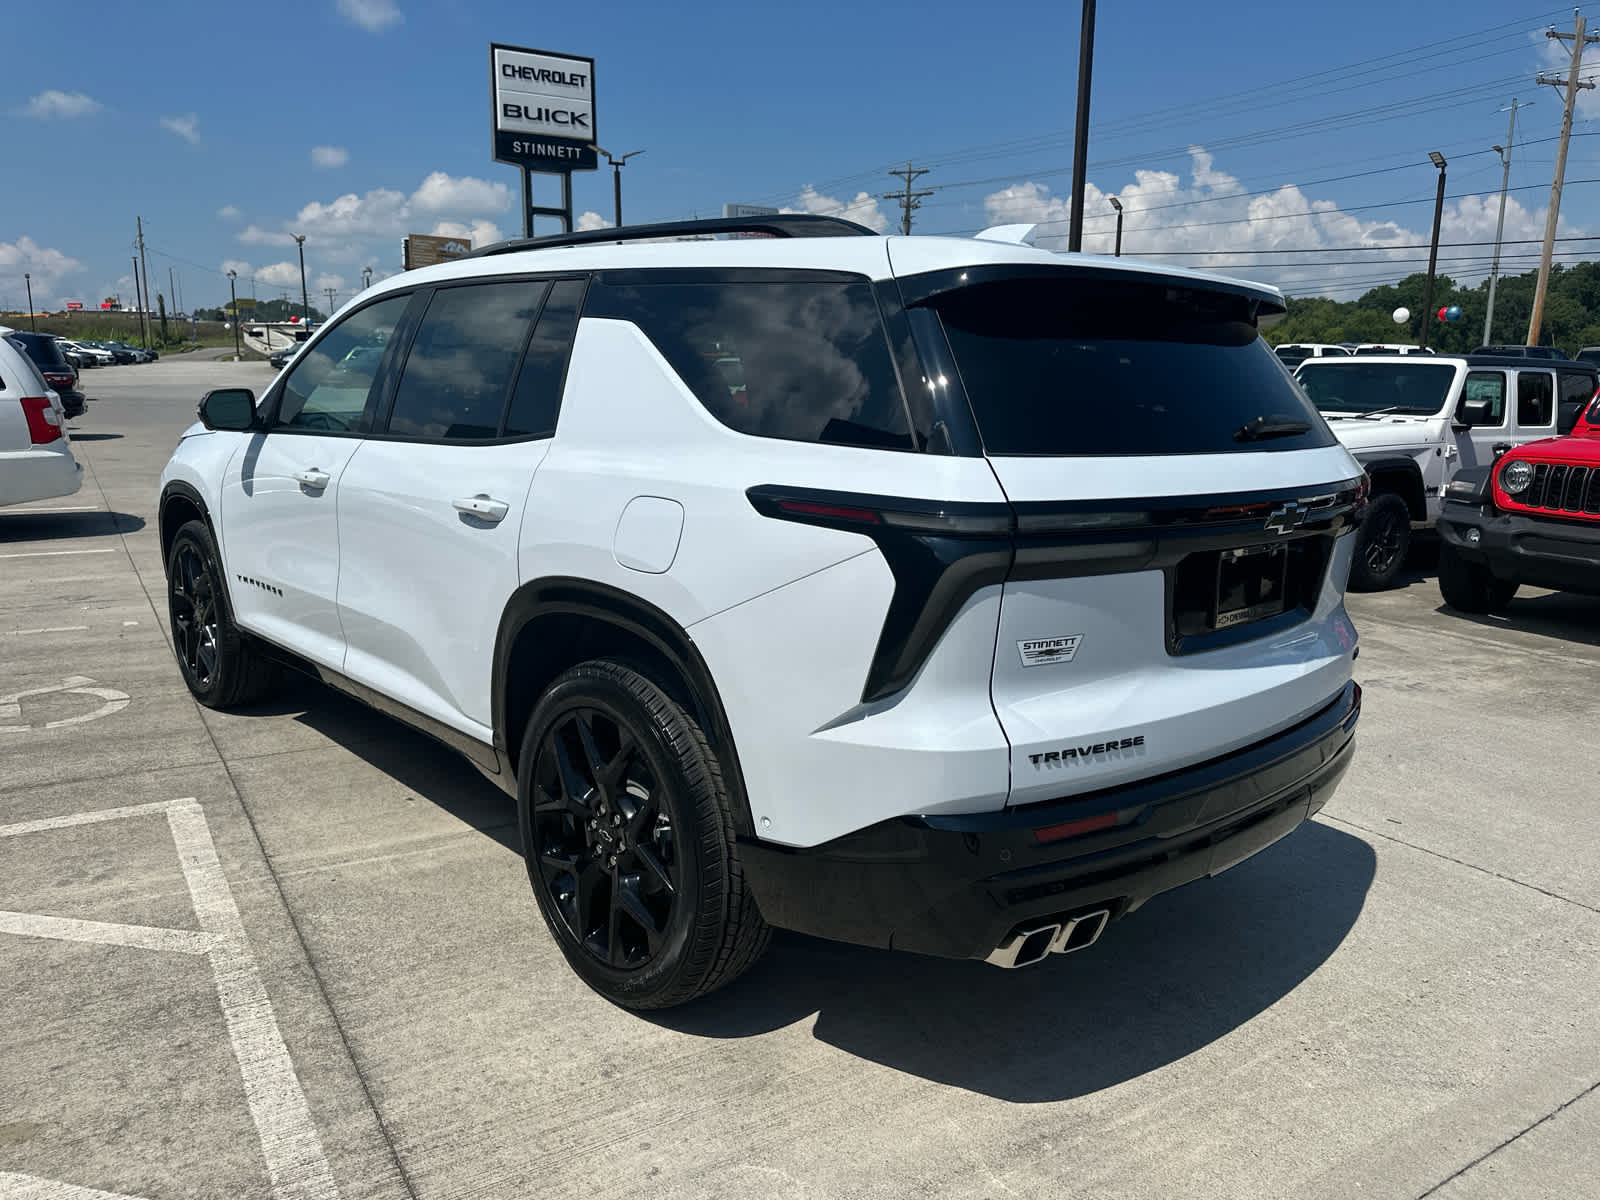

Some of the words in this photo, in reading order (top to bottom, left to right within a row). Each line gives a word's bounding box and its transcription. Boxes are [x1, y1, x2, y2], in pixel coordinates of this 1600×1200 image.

[502, 64, 587, 87] CHEVROLET
[503, 103, 589, 127] BUICK
[513, 141, 582, 159] STINNETT
[236, 574, 283, 597] TRAVERSE
[1023, 638, 1077, 650] STINNETT
[1028, 736, 1144, 764] TRAVERSE
